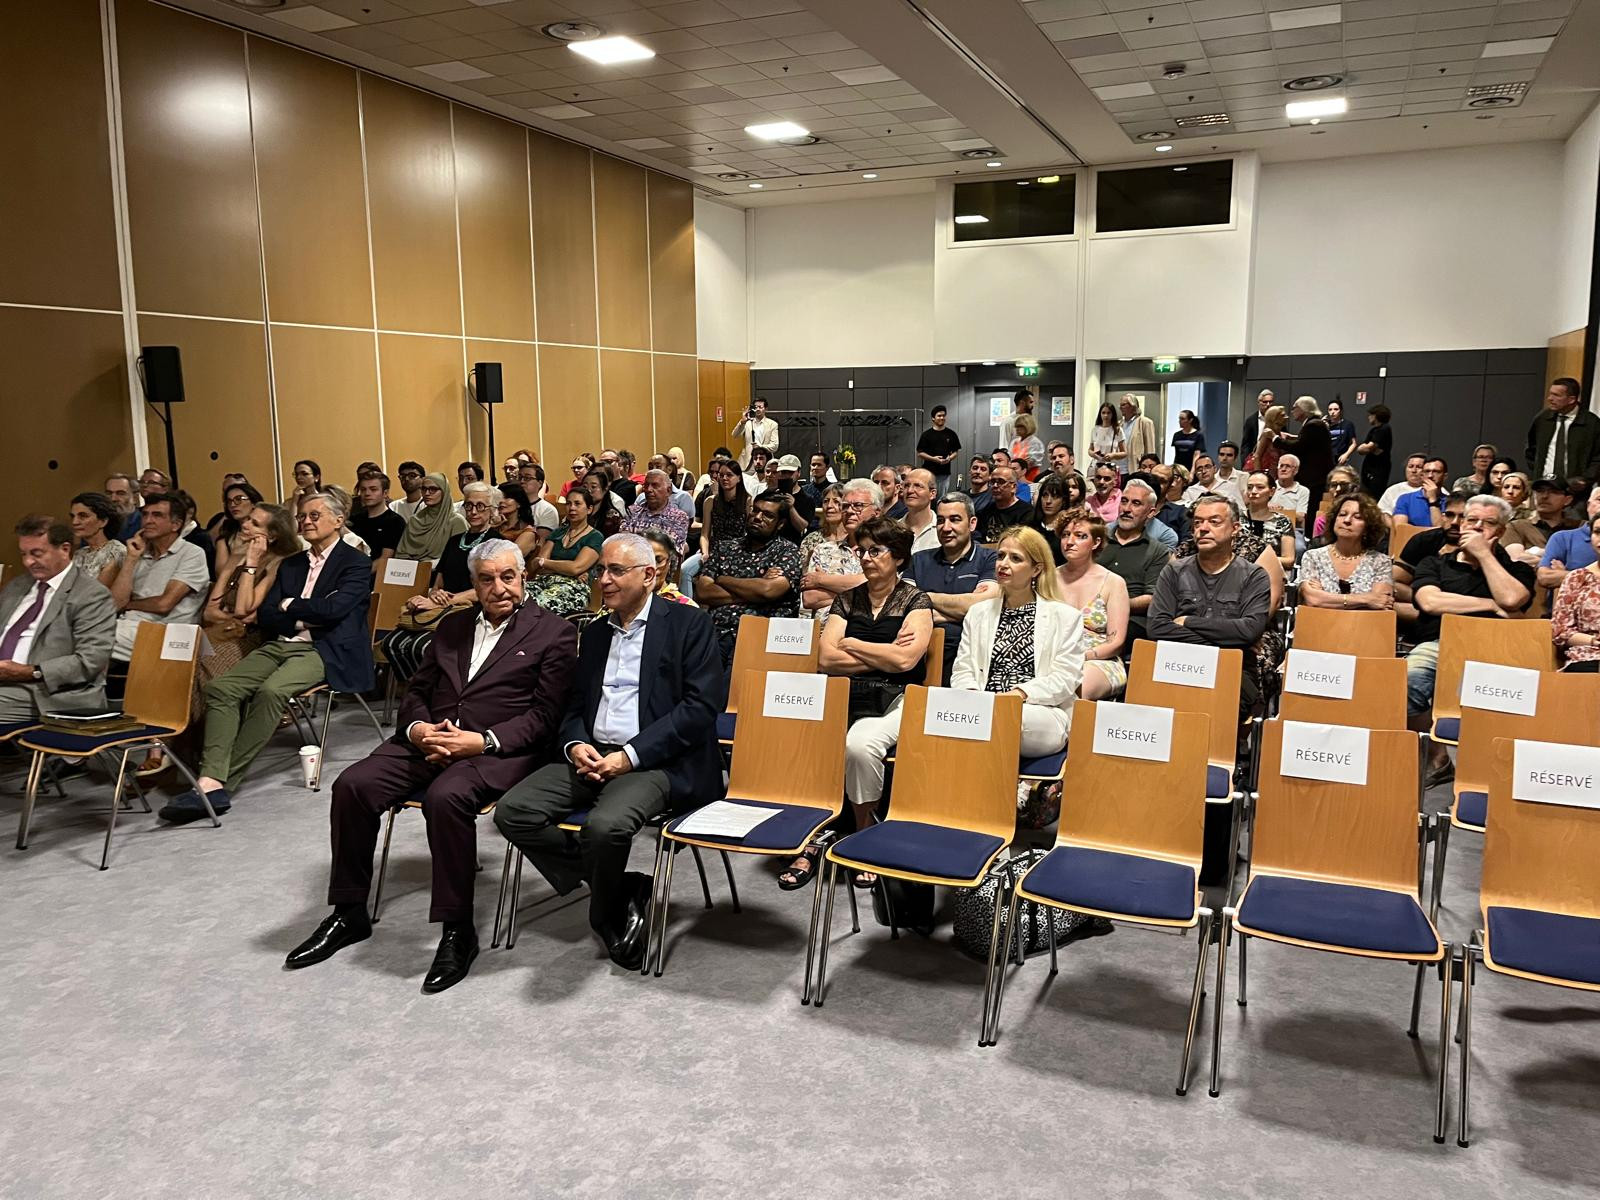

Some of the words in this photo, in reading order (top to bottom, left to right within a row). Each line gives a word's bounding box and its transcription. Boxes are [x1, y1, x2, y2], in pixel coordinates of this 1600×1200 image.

[774, 634, 804, 644] RÉSERVÉ
[1164, 661, 1206, 675] RÉSERVÉ
[1297, 670, 1341, 684] RÉSERVÉ
[775, 693, 814, 705] RÉSERVÉ
[1474, 684, 1523, 700] RÉSERVÉ
[937, 710, 980, 724] RÉSERVÉ
[1107, 727, 1157, 743] RÉSERVÉ
[1296, 748, 1351, 765] RÉSERVÉ
[1530, 769, 1593, 788] RÉSERVÉ
